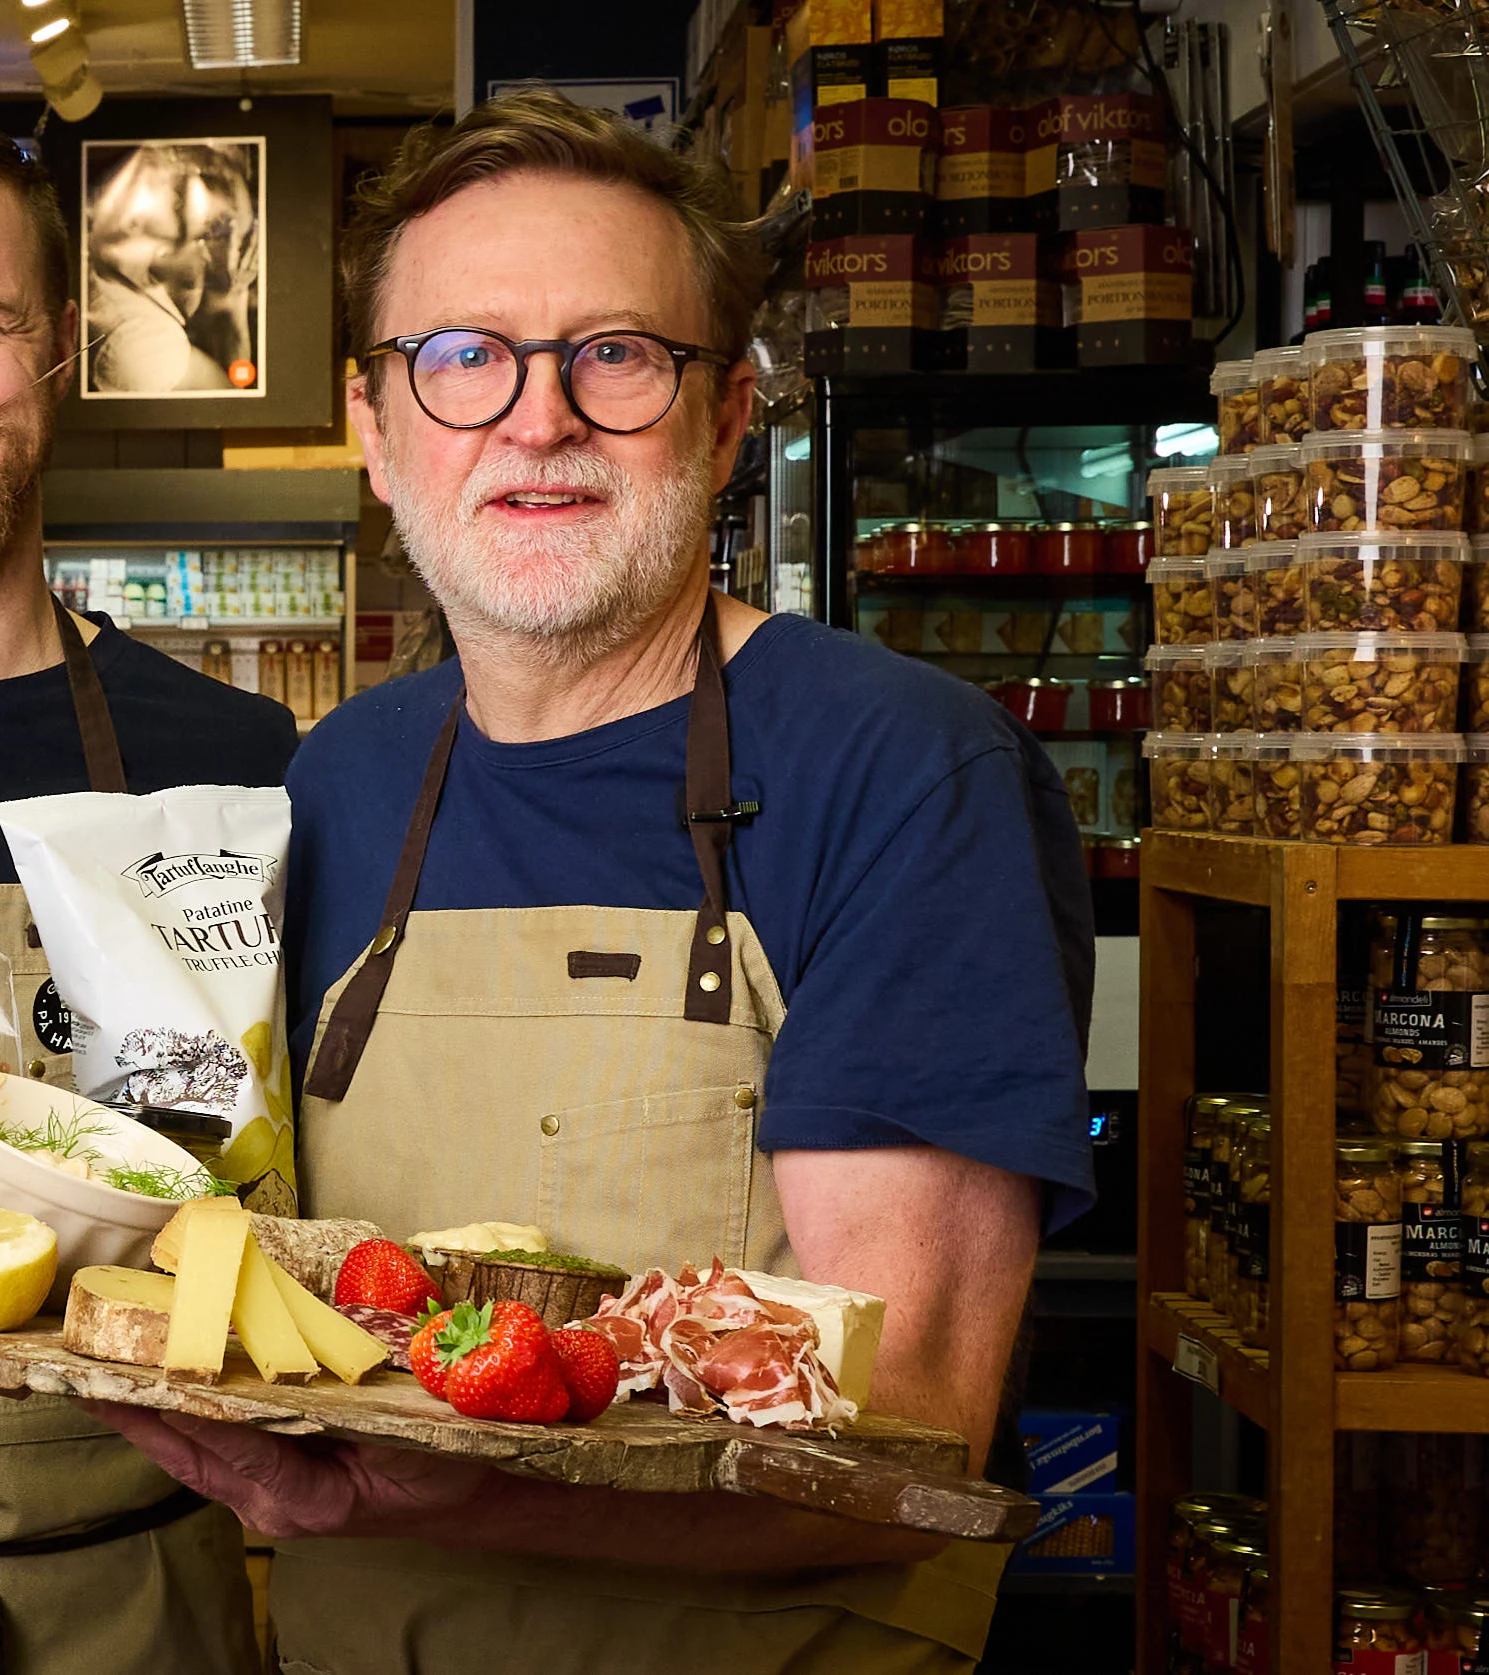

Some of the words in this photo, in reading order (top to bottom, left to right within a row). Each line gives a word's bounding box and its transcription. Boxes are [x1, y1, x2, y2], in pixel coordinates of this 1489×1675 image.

[813, 249, 888, 277] viktors
[182, 899, 254, 923] Patatine
[182, 955, 253, 972] TRUFFLE
